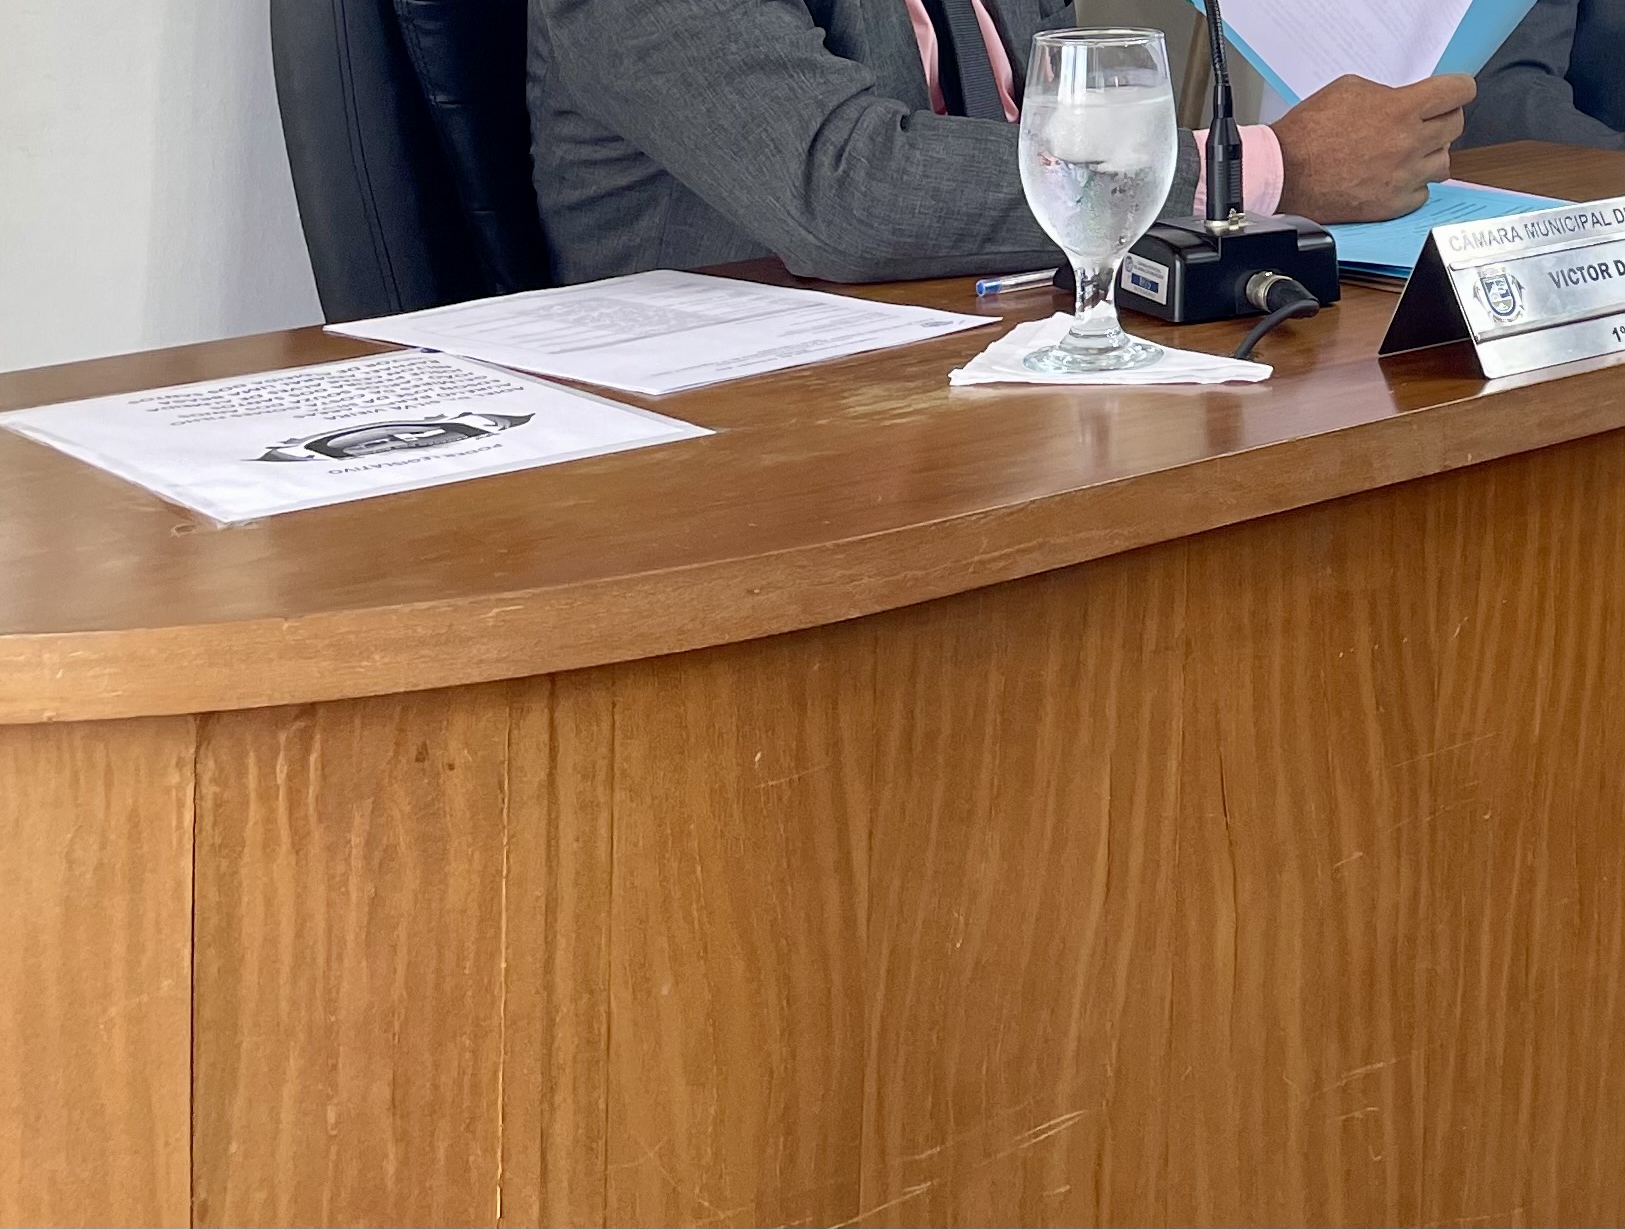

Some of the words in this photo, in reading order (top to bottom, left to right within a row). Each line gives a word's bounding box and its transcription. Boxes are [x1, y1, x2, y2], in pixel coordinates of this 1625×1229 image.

[1449, 225, 1522, 252] CÂMARA
[1526, 212, 1612, 243] MUNICIPAL
[1548, 262, 1612, 289] VICTOR
